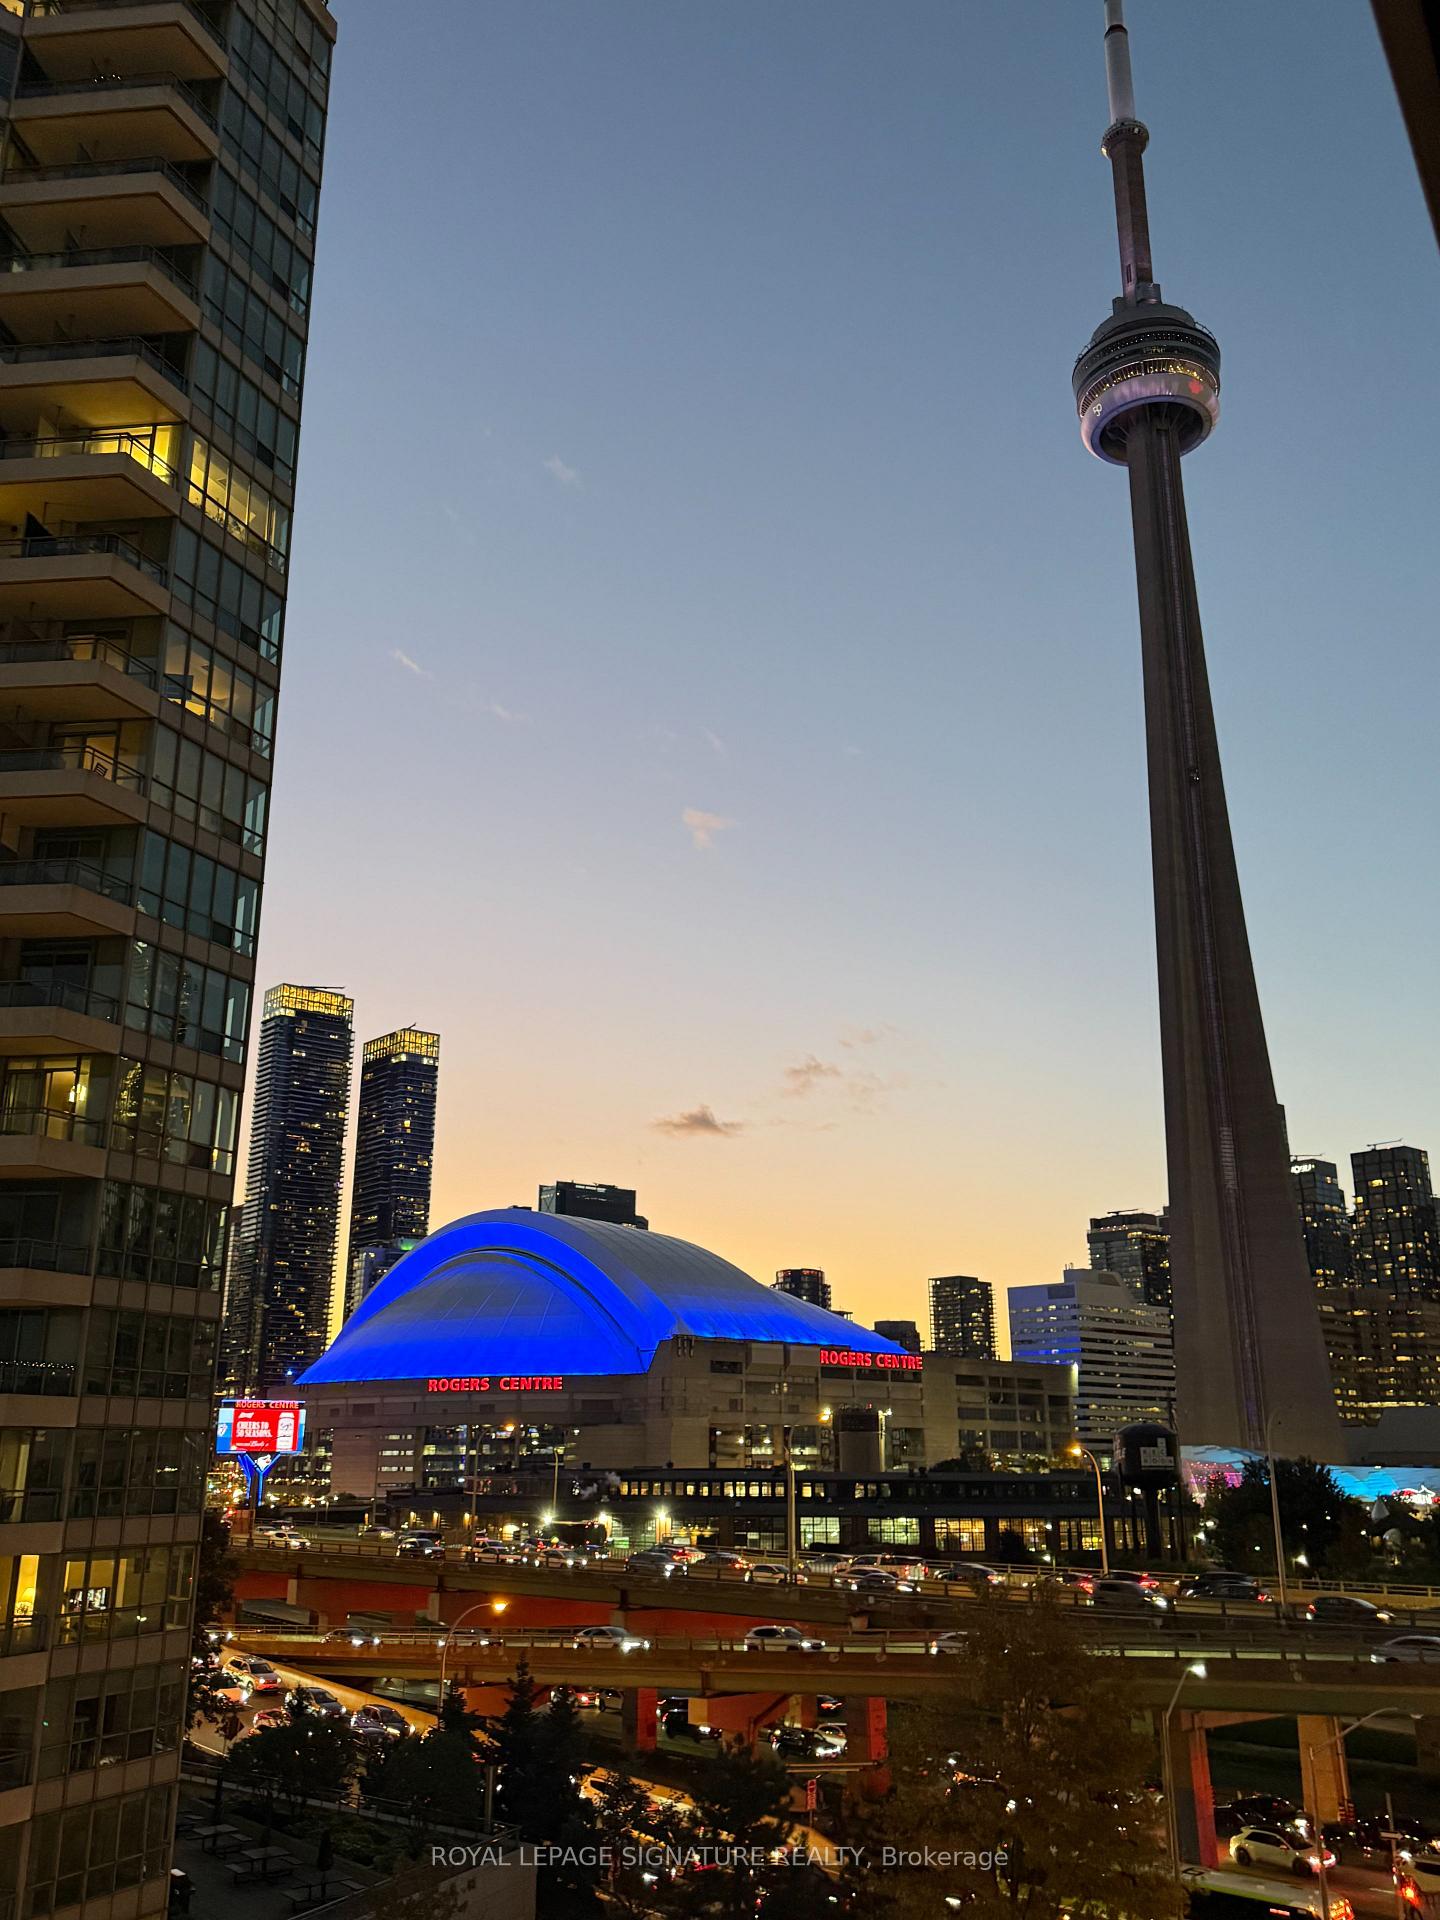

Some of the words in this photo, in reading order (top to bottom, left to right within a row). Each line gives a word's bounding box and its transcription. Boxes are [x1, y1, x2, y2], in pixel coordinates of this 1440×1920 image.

[820, 1349, 872, 1367] ROGERS
[876, 1353, 924, 1370] CENTRE
[428, 1377, 490, 1392] ROGERS
[499, 1376, 563, 1390] CENTRE
[235, 1400, 266, 1409] ROGERS
[269, 1401, 299, 1409] CENTRE
